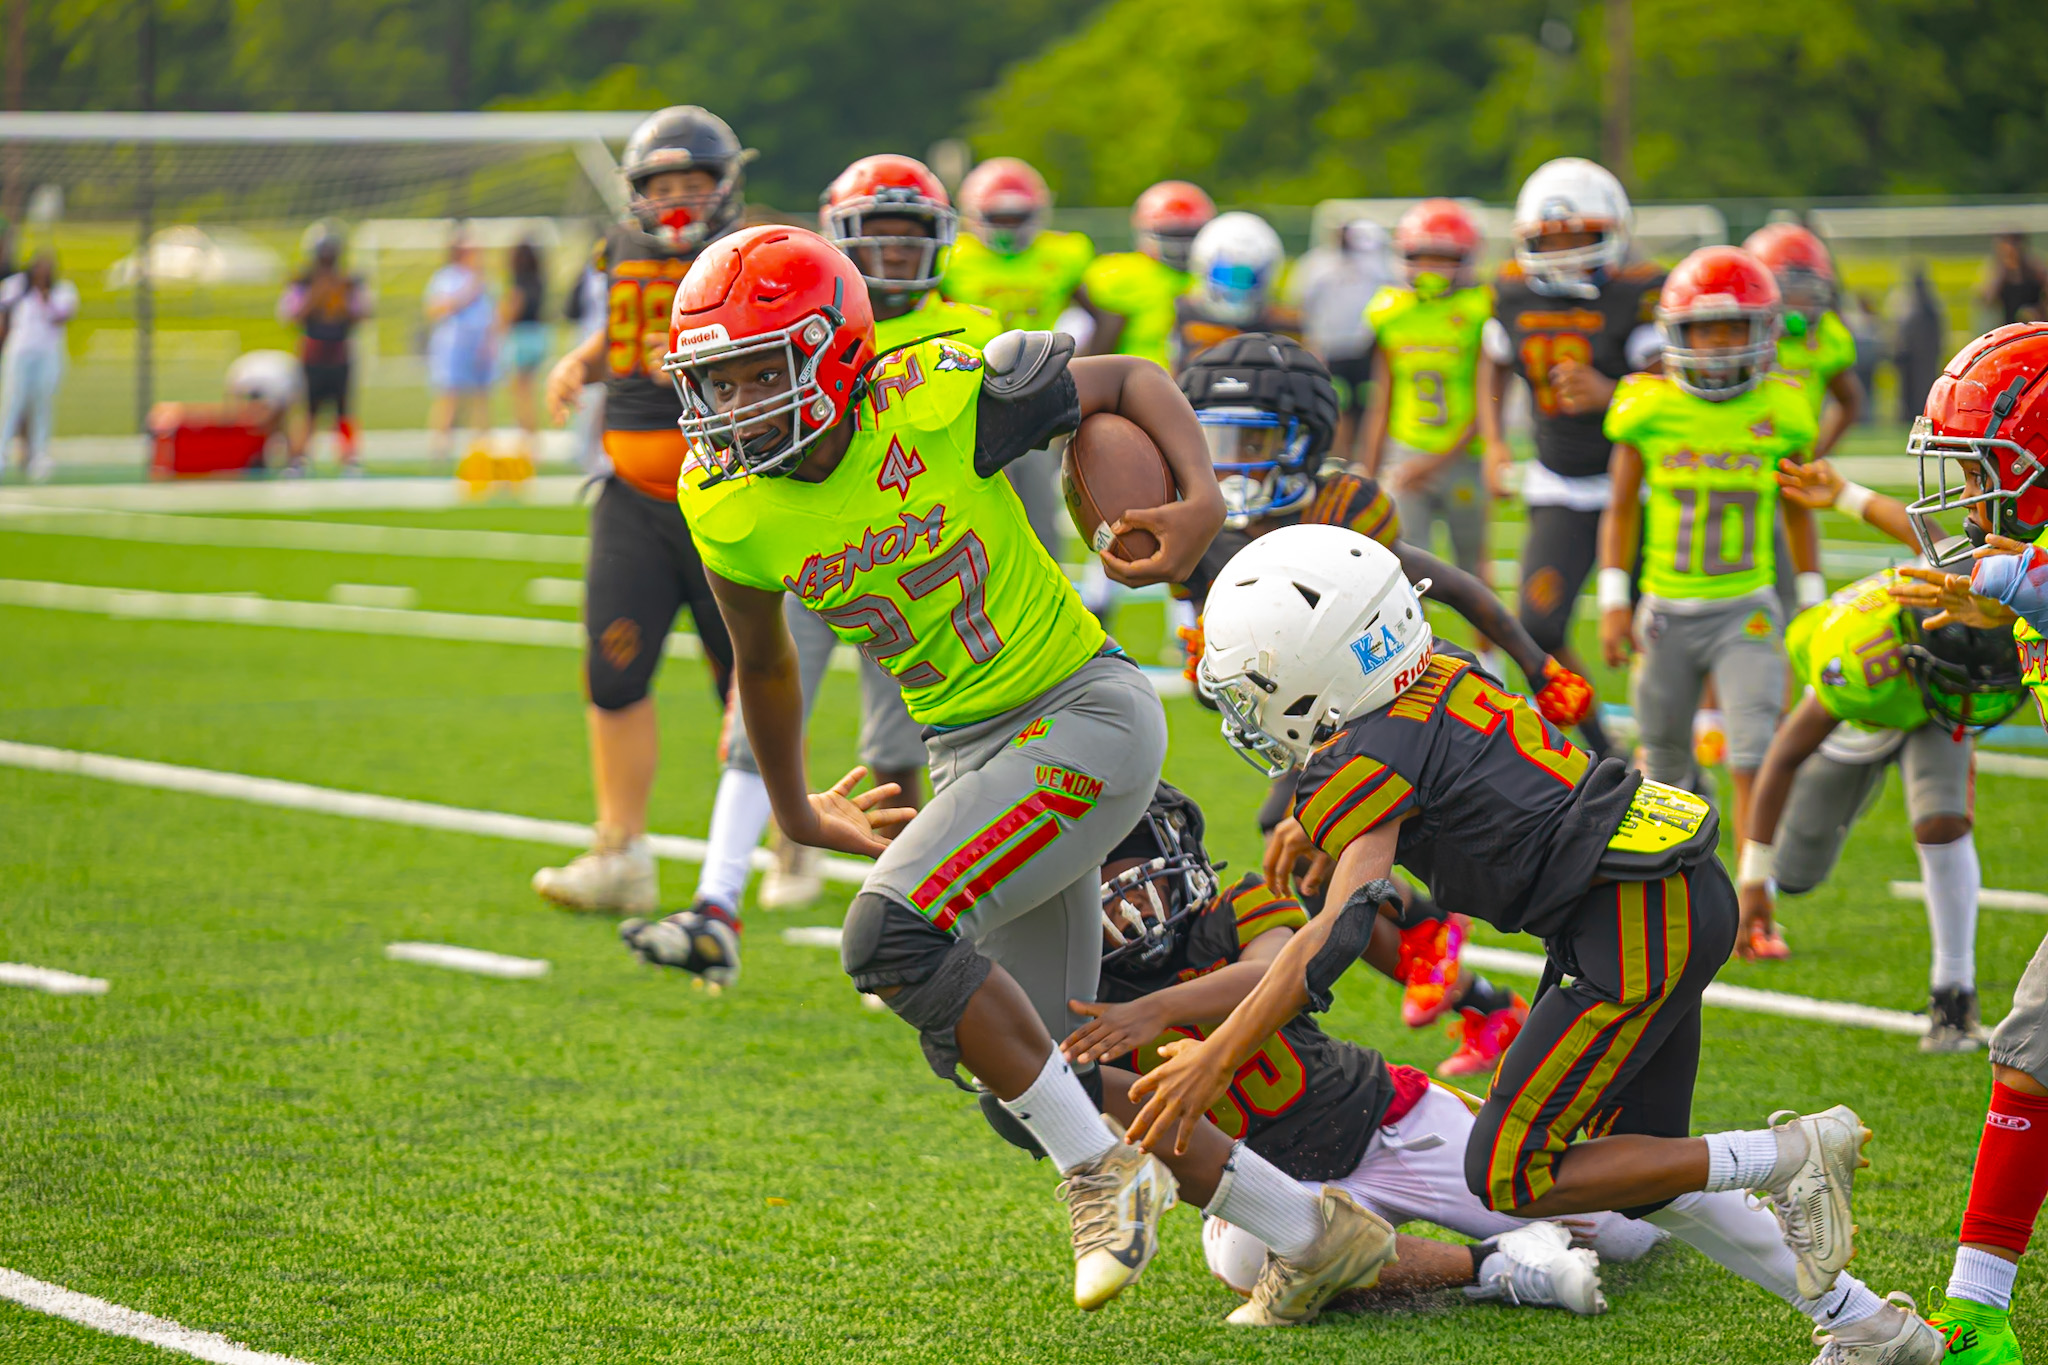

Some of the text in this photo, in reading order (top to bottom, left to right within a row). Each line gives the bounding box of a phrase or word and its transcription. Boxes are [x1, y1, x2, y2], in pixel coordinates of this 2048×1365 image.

[783, 503, 946, 601] VENOM
[1672, 488, 1760, 576] 10
[815, 528, 1005, 689] 27
[1386, 653, 1472, 723] WILLIA
[1393, 639, 1434, 696] Ridd
[1445, 670, 1591, 791] 2
[1035, 765, 1105, 801] VENOM
